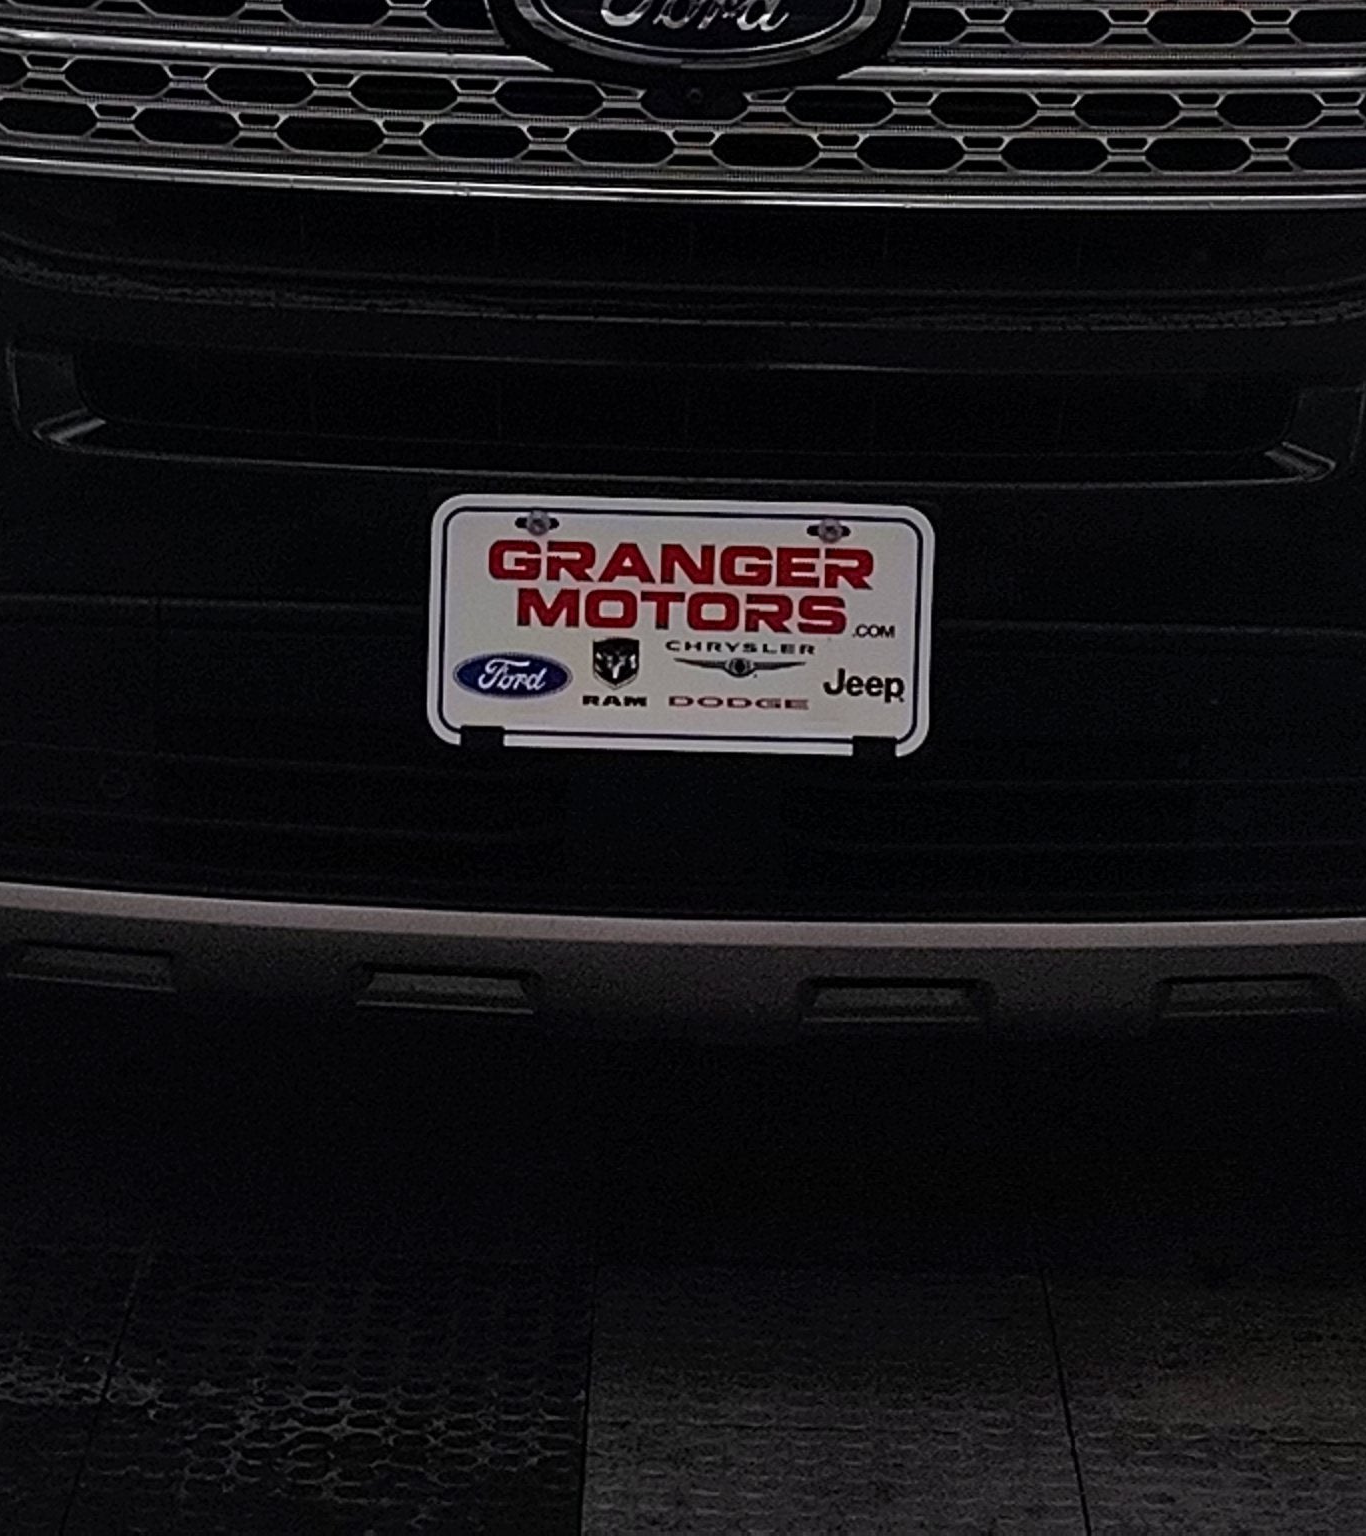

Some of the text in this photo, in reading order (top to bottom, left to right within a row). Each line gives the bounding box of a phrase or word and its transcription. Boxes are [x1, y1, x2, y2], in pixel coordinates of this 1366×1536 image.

[488, 538, 874, 591] GRANGER
[516, 588, 848, 635] MOTORS
[665, 640, 816, 655] CHRYSLER
[477, 659, 546, 693] Ford
[823, 667, 905, 703] Jeep
[582, 695, 647, 707] RAM
[668, 695, 810, 710] DODGE
